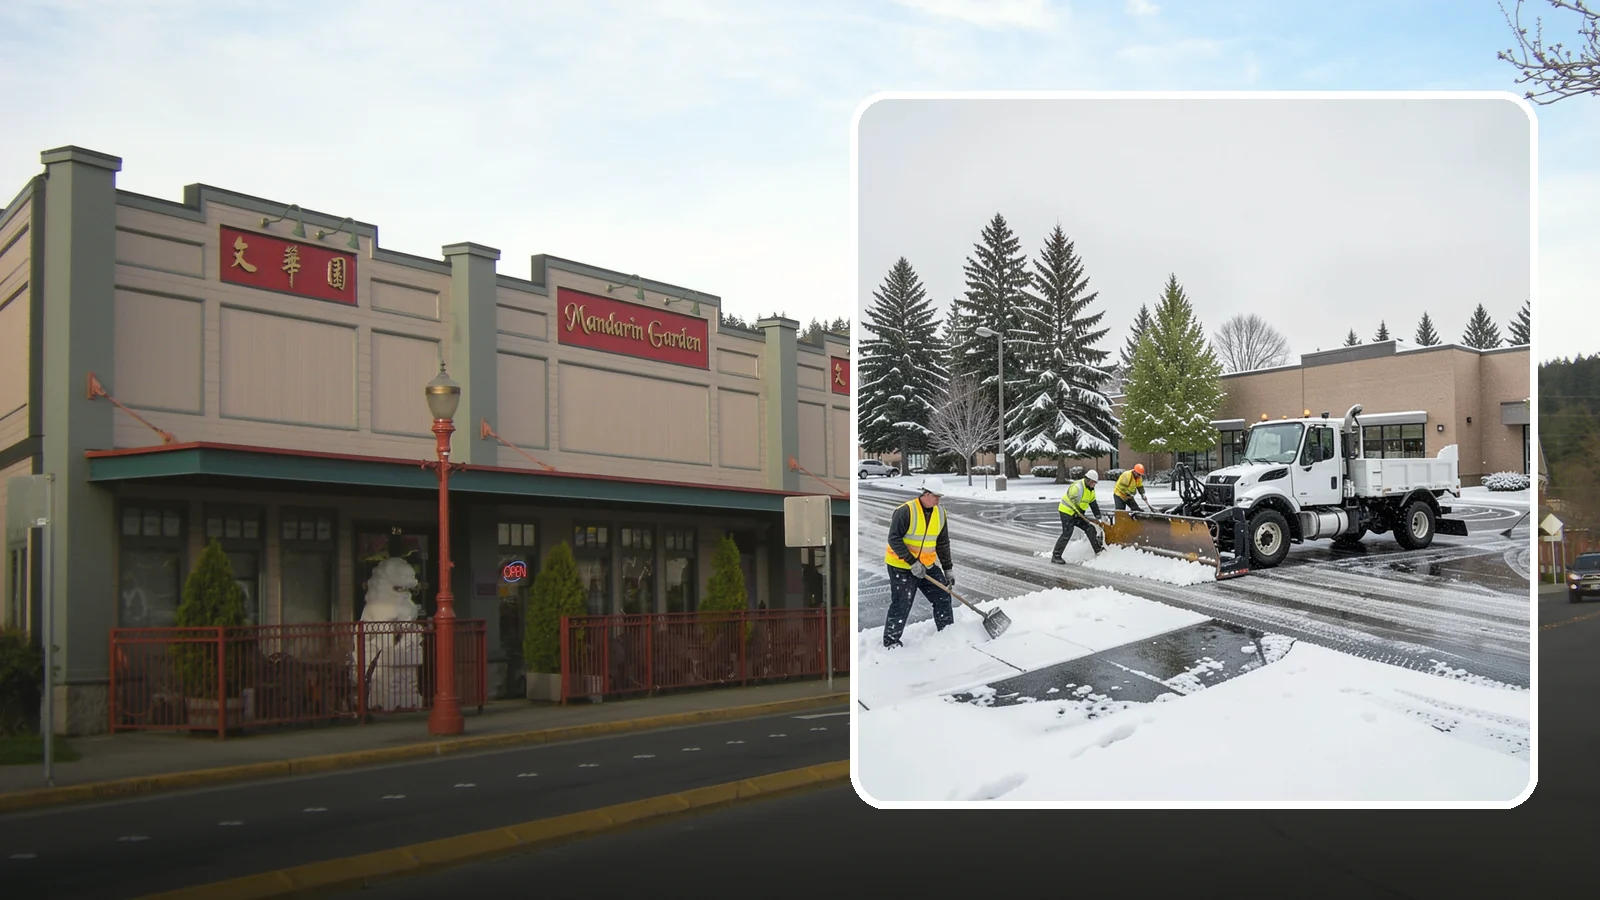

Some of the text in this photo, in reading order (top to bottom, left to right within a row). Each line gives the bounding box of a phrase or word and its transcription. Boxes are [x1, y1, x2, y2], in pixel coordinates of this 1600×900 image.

[231, 236, 346, 291] 文華園
[564, 302, 702, 352] Mandarin Garden
[503, 565, 527, 578] OPEN
